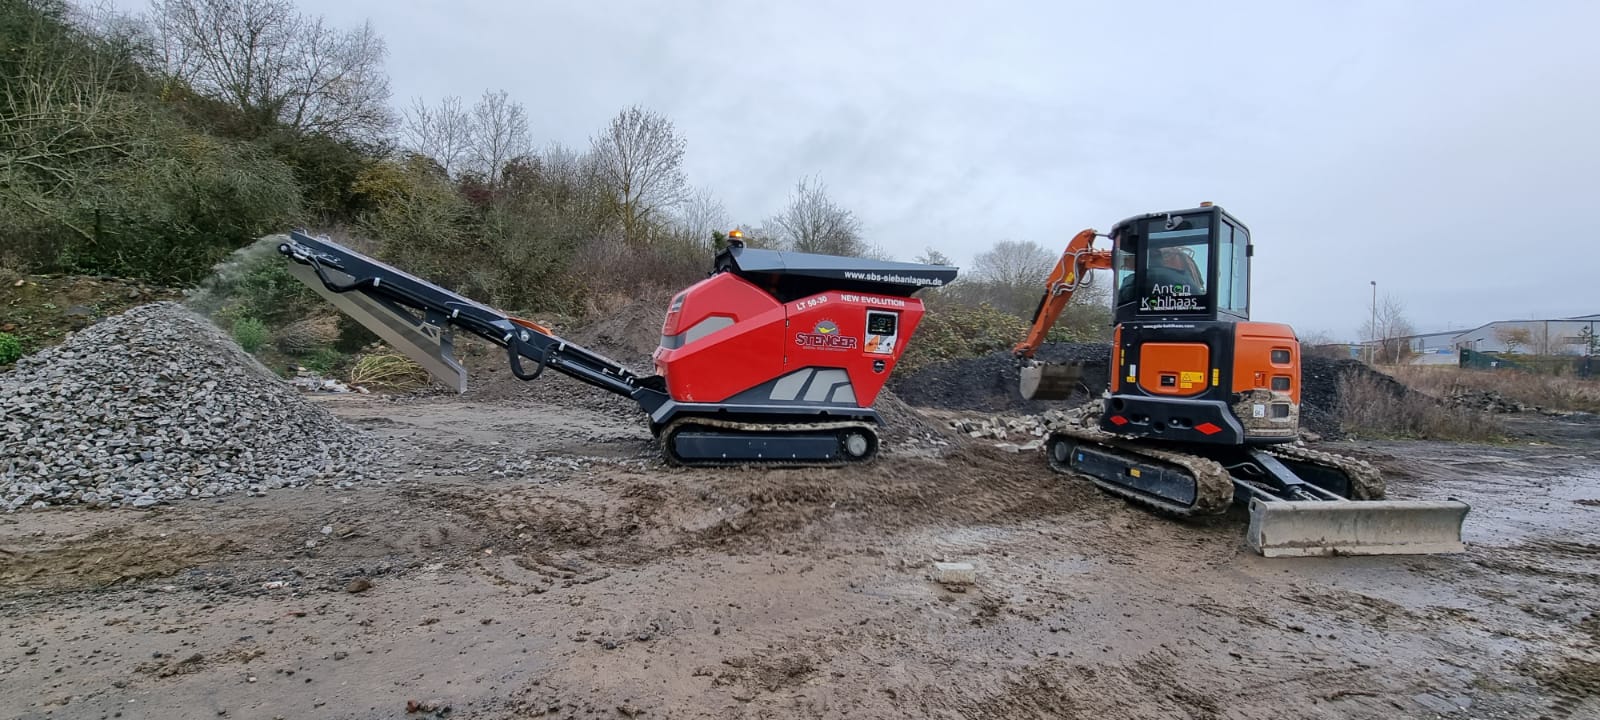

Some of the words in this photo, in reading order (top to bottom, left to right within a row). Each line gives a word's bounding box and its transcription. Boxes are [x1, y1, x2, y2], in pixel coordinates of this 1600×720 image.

[844, 271, 943, 286] www.sbs-siebanlagen.de
[1151, 283, 1191, 294] Anton
[796, 303, 806, 311] LT
[807, 295, 828, 308] 50-30
[840, 294, 860, 303] NEW
[861, 296, 905, 307] EVOLUTION
[1141, 295, 1197, 307] Kohlhaas
[795, 332, 857, 349] STENGER
